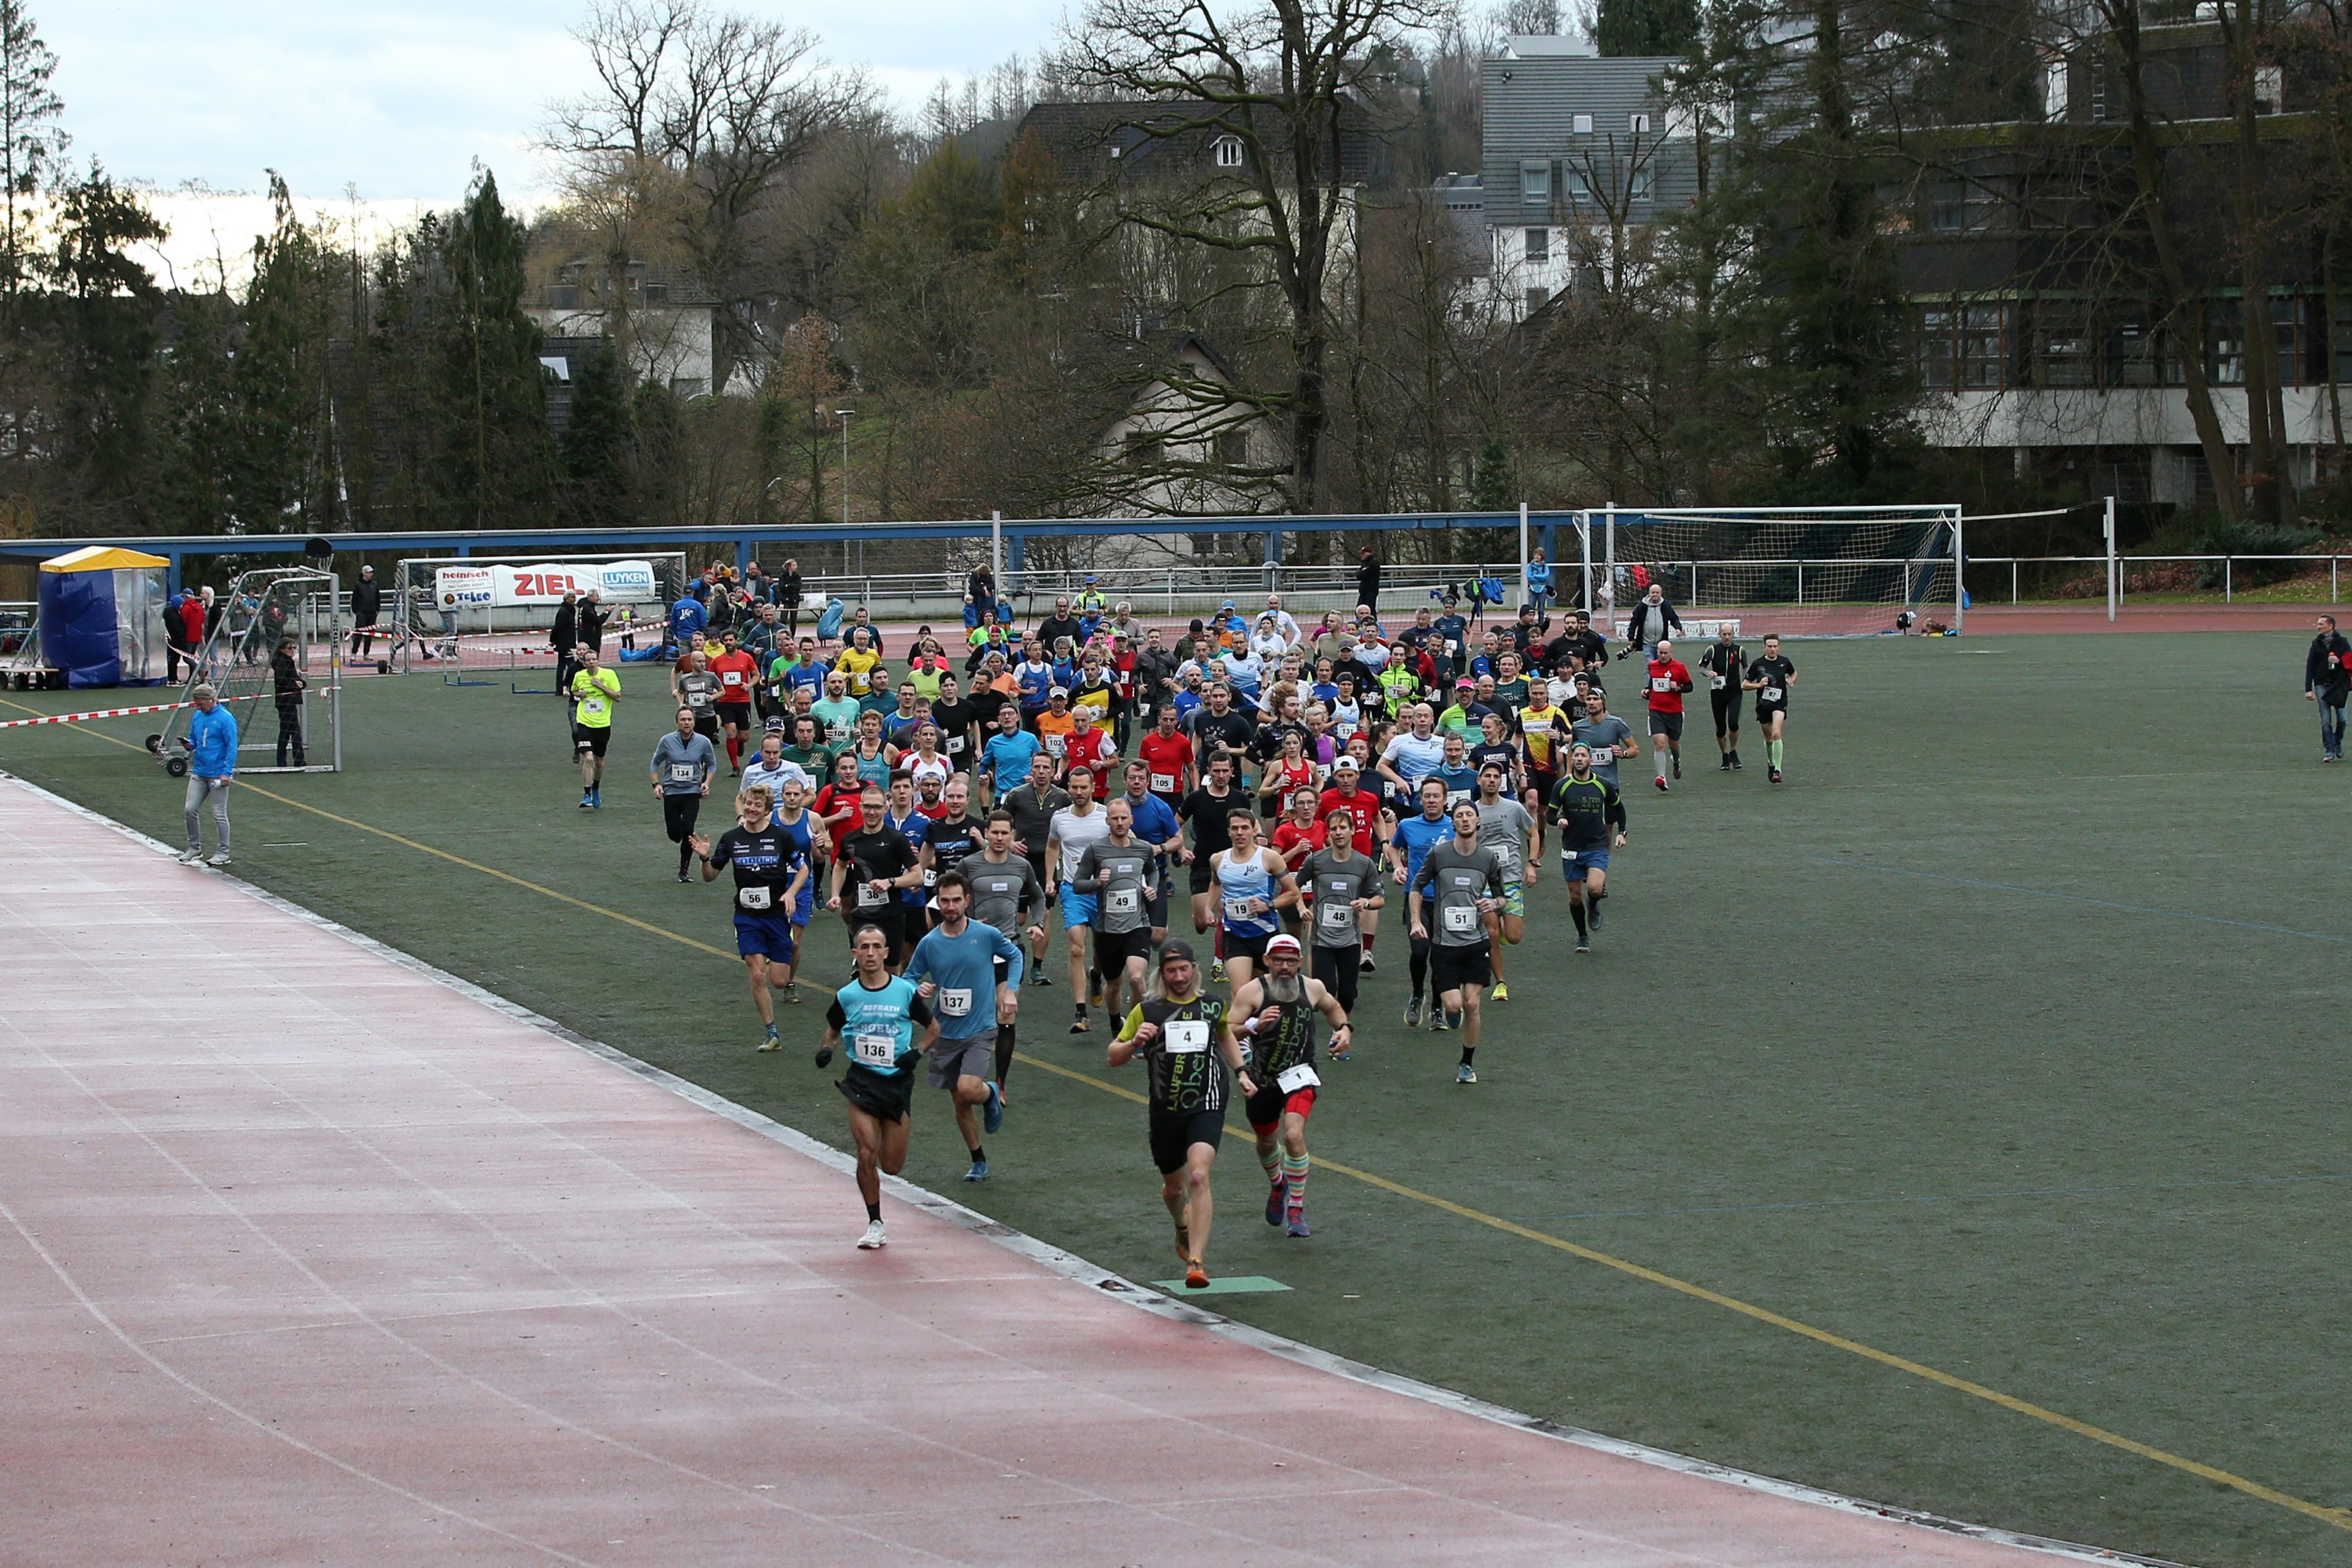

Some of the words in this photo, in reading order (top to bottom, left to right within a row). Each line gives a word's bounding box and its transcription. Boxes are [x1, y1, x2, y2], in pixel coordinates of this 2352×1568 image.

[443, 571, 489, 579] heinisch
[604, 571, 648, 584] LUYKEN
[513, 573, 586, 596] ZIEL
[1155, 779, 1168, 787] 105
[749, 894, 761, 903] 56
[1115, 897, 1128, 906] 49
[1234, 905, 1247, 914] 19
[1332, 912, 1346, 921] 48
[1455, 914, 1467, 924] 51
[944, 997, 964, 1008] 137
[863, 1004, 900, 1012] REFRATH
[1183, 1031, 1192, 1042] 4
[863, 1044, 886, 1057] 136
